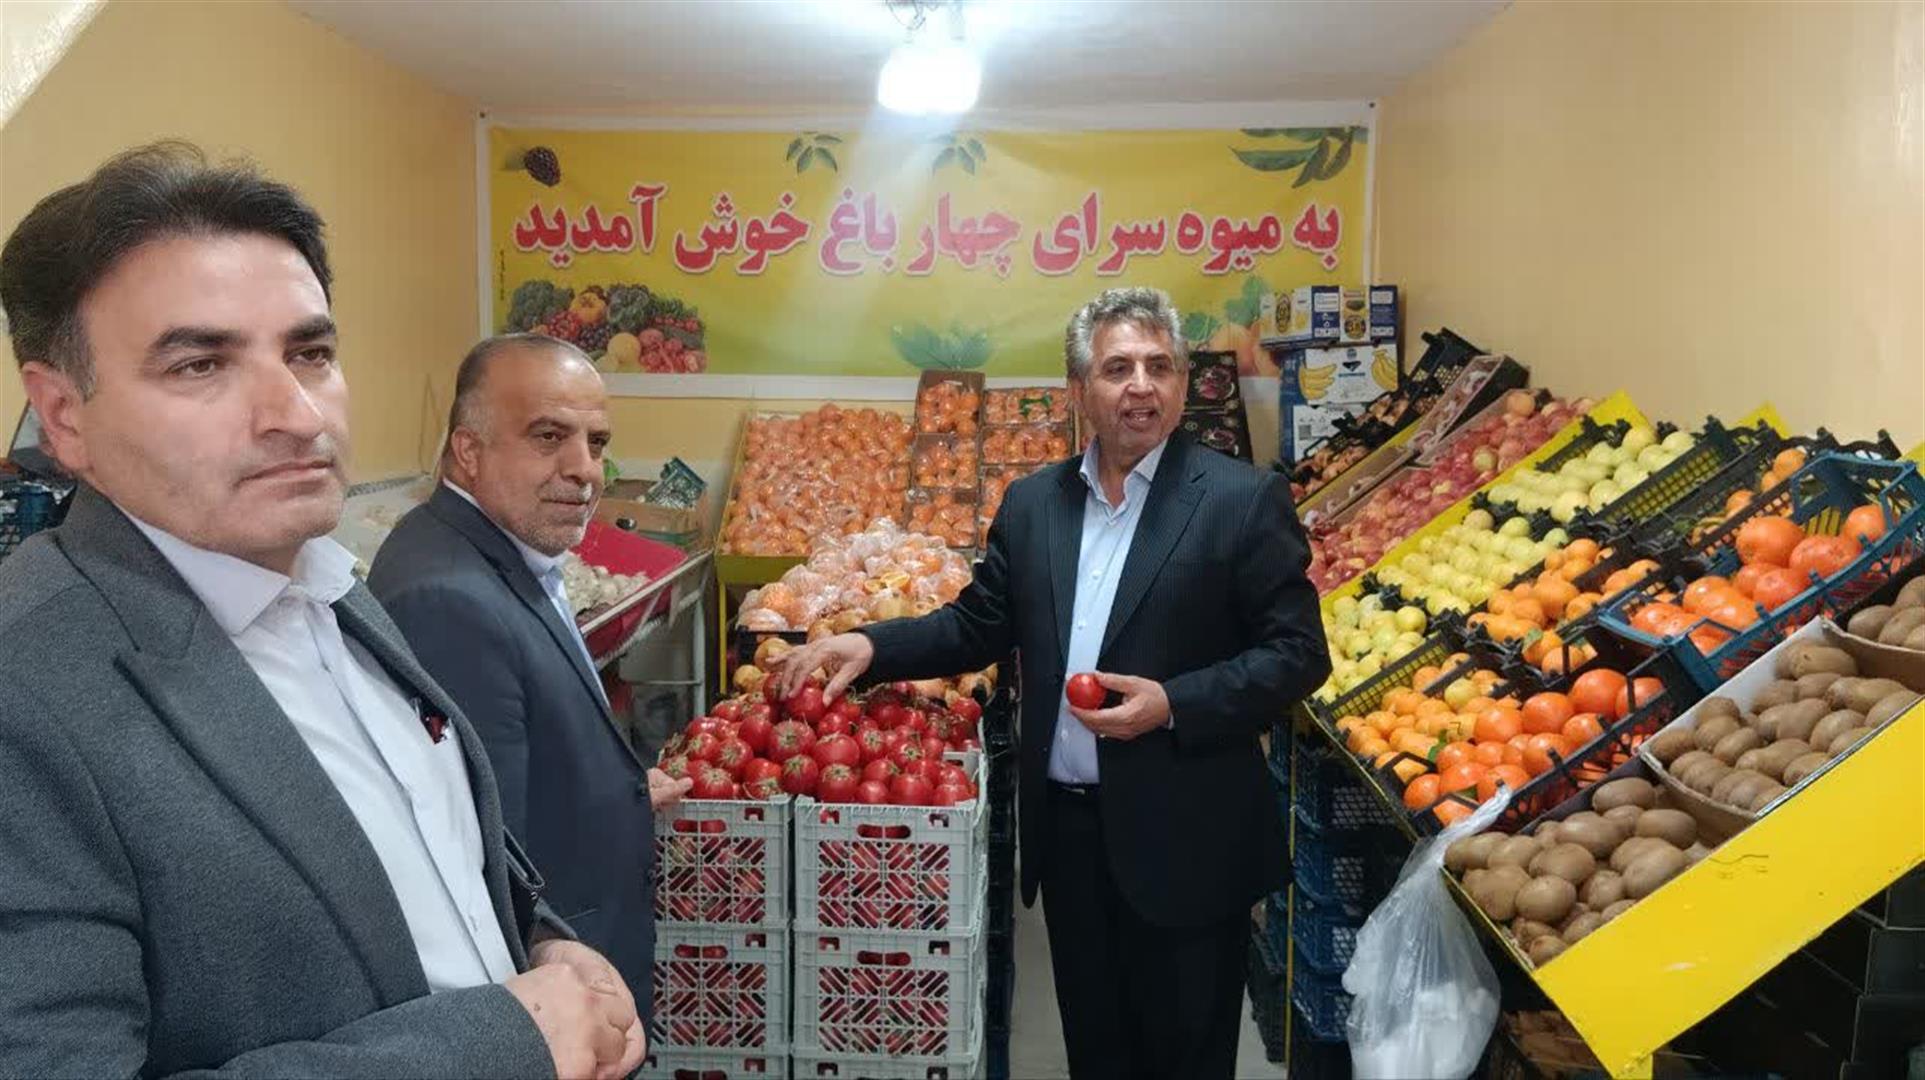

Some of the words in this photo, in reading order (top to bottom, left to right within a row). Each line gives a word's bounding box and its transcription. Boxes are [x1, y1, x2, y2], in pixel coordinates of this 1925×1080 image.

[513, 185, 664, 267] آمدید
[674, 192, 810, 273] خوش
[820, 187, 898, 273] باغ
[906, 192, 1022, 274] چهار
[1033, 192, 1167, 274] سرای
[1176, 212, 1283, 273] میوه
[1293, 204, 1341, 268] به
